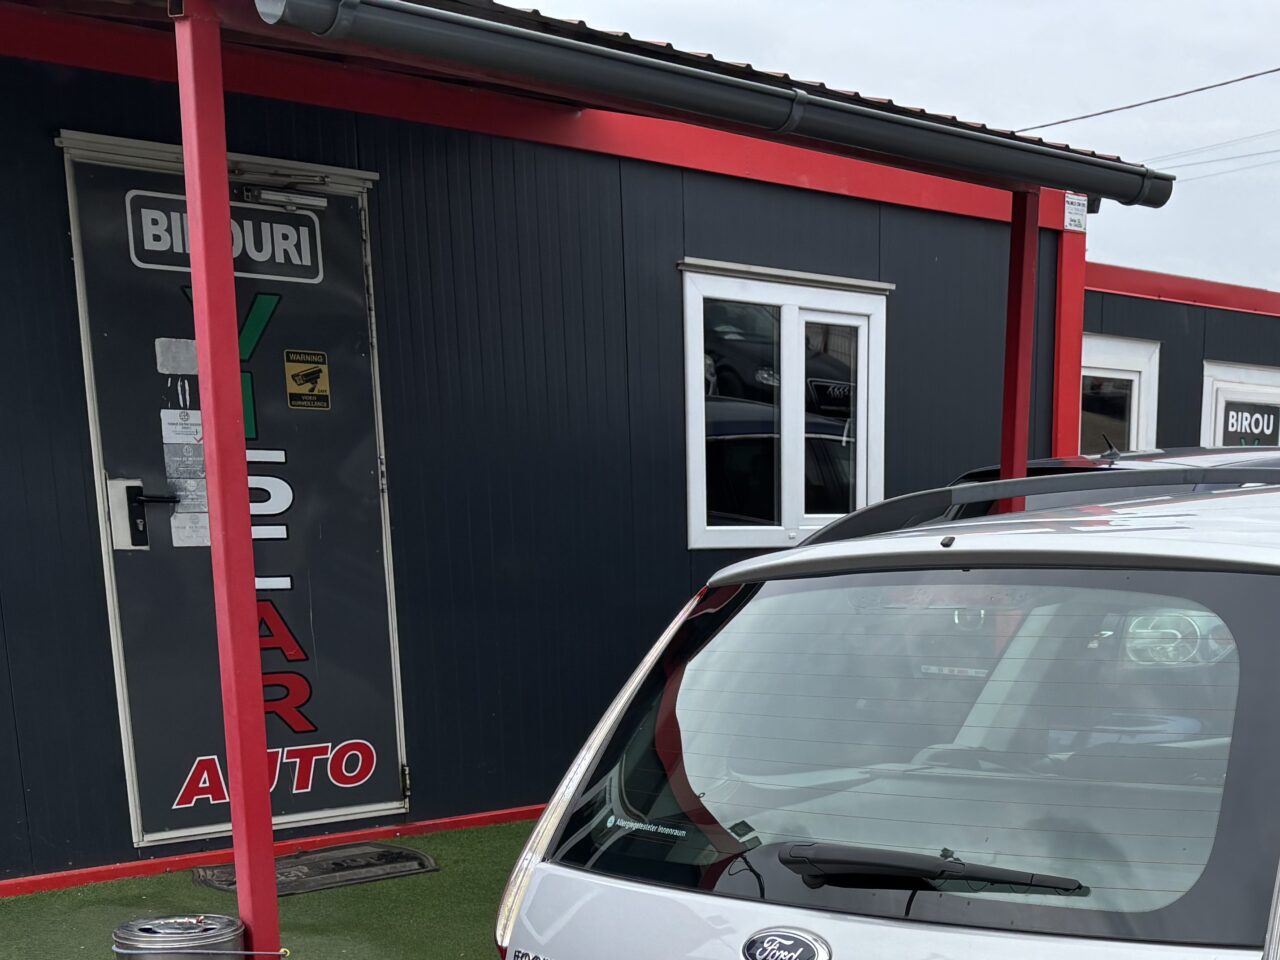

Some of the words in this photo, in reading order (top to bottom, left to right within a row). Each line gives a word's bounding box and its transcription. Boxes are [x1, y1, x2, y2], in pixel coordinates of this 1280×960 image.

[141, 208, 311, 266] BIURI
[289, 353, 323, 362] WARNING
[1228, 410, 1274, 435] BIROU
[171, 739, 377, 810] ATO
